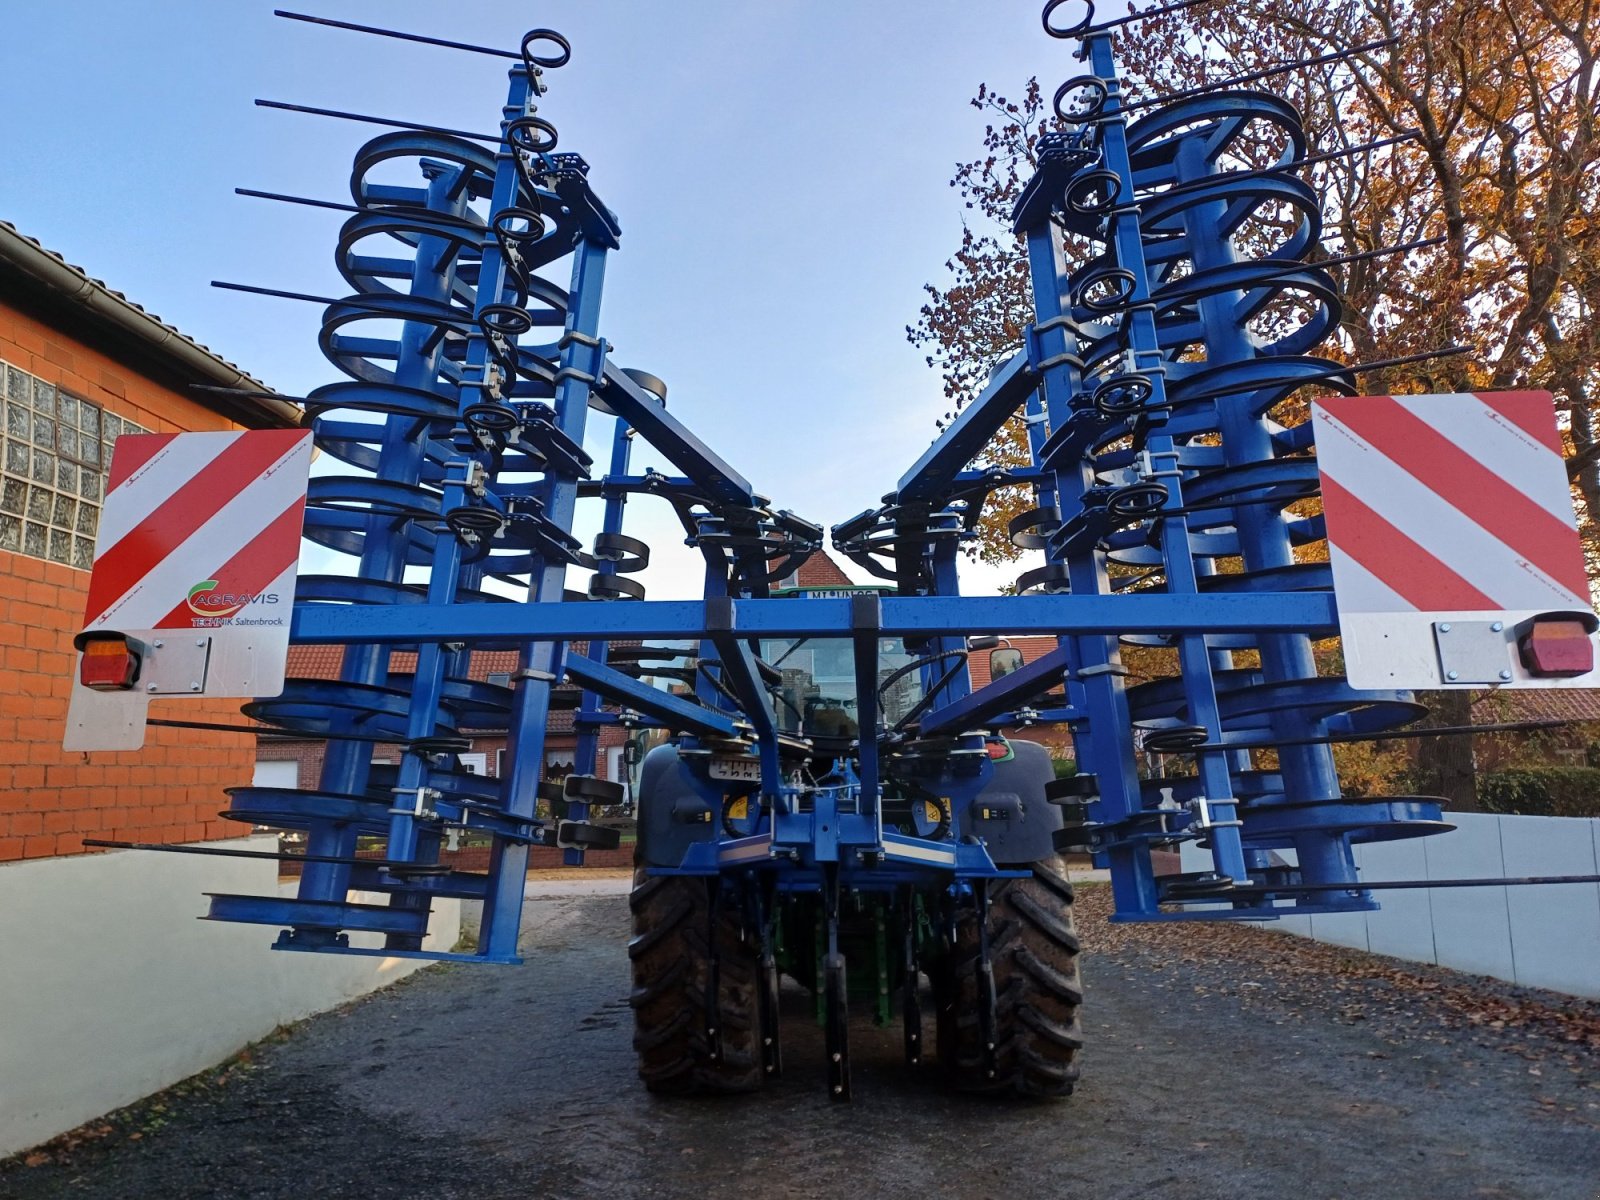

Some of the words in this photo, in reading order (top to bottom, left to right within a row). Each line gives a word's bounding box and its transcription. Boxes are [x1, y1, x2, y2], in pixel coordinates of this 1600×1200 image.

[193, 593, 279, 606] AGRAVIS
[191, 617, 233, 627] TECHNIK
[235, 617, 283, 626] Saltenbrock
